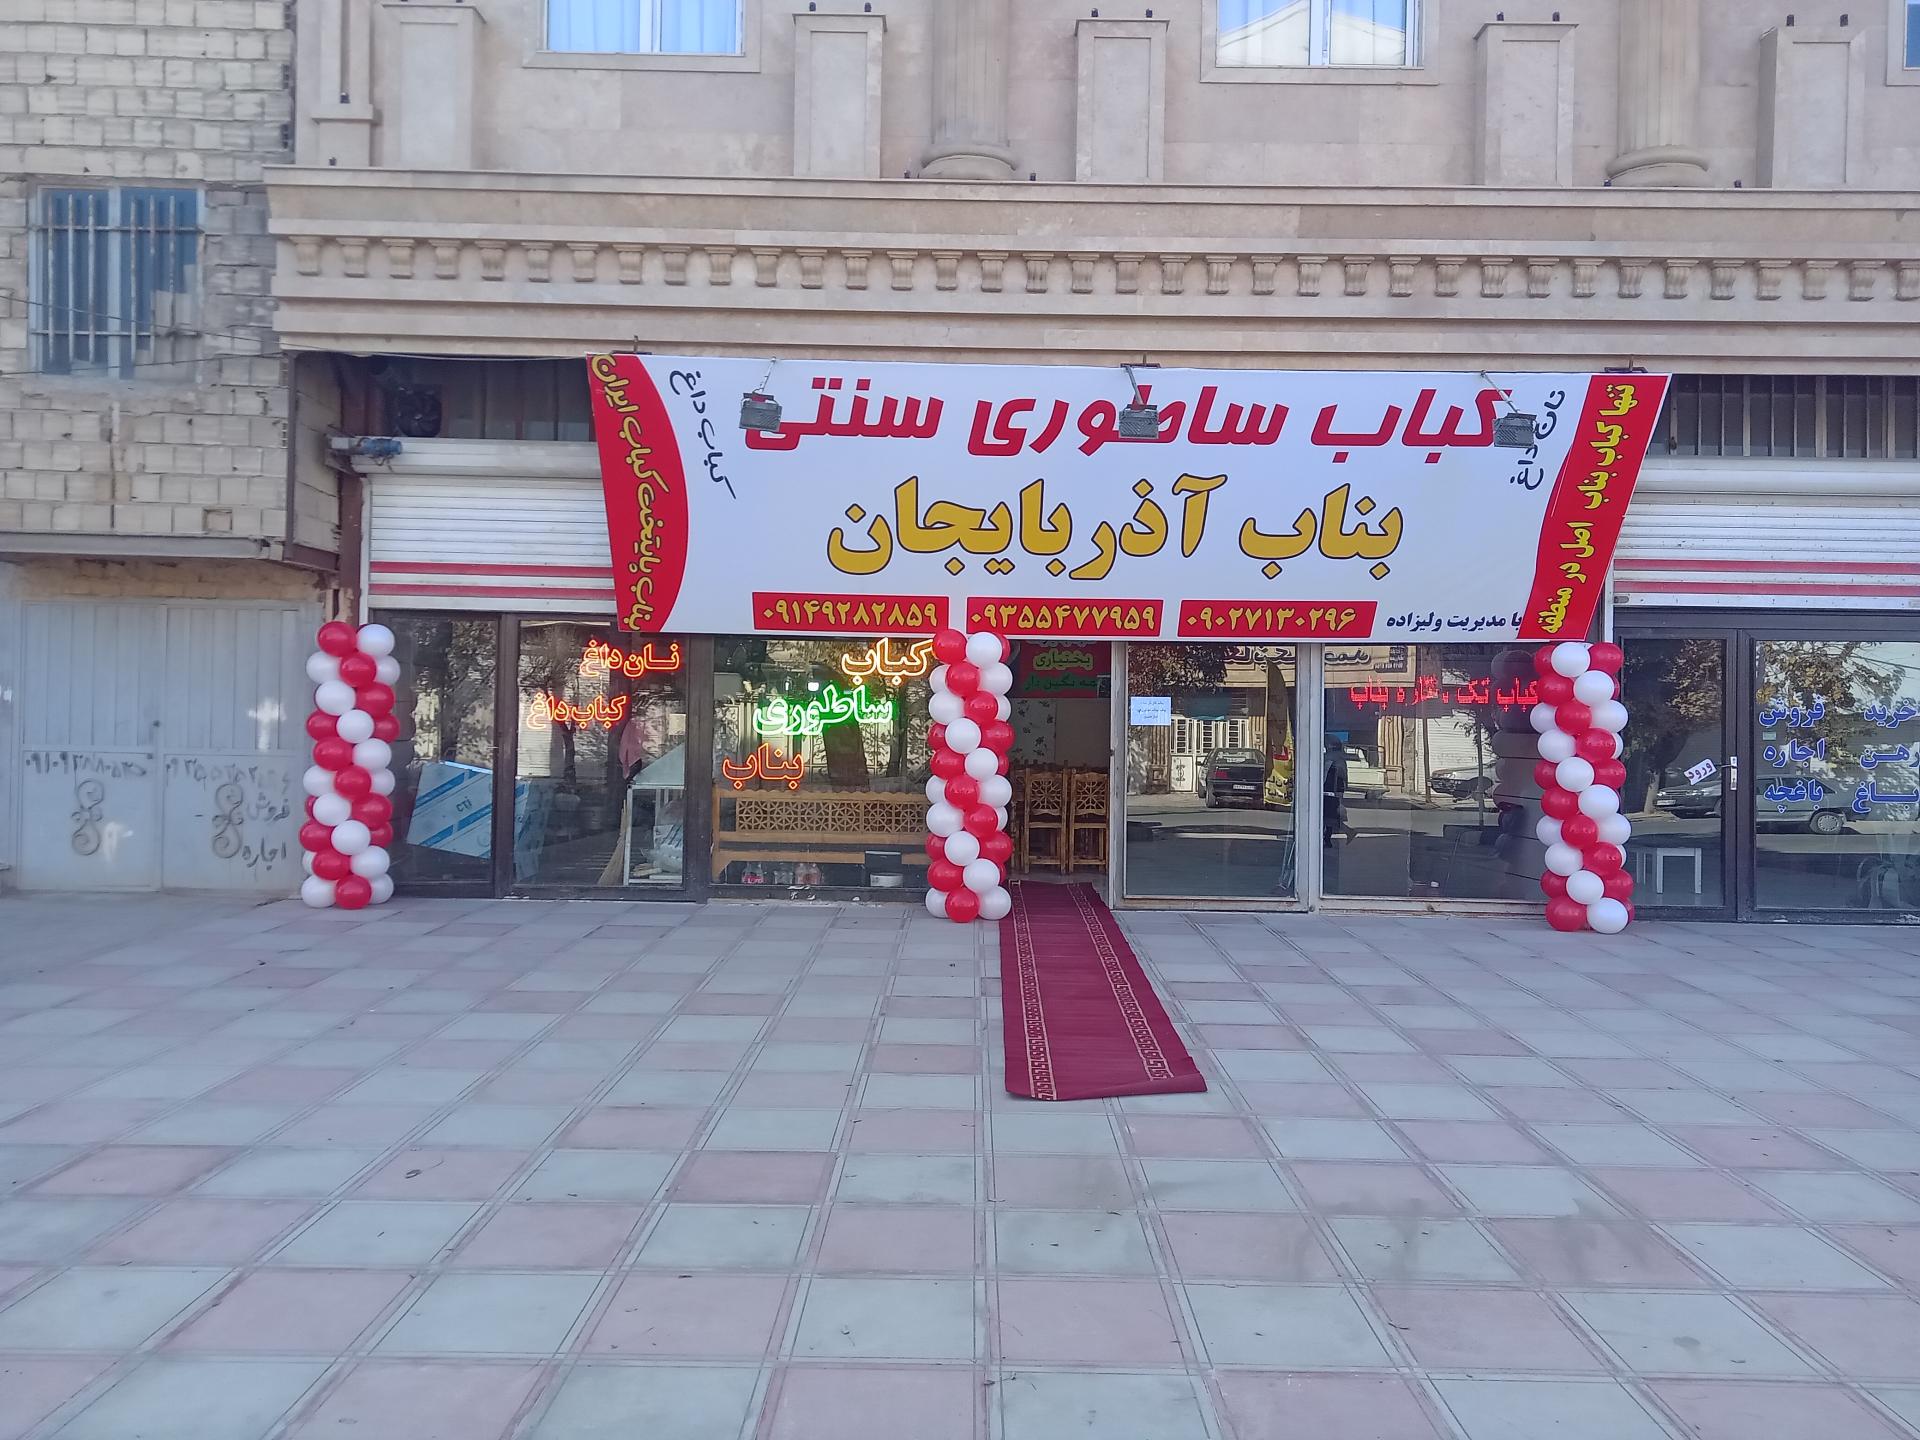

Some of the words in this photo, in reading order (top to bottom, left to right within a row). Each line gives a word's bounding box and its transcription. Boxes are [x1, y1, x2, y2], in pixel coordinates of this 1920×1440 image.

[591, 354, 640, 413] ایران
[669, 370, 706, 414] داغ
[1598, 383, 1639, 416] تنها
[745, 377, 943, 451] سنتی
[967, 385, 1289, 456] ساطوری
[1311, 389, 1513, 464] کباب
[1535, 390, 1566, 440] نان
[618, 416, 669, 492] کباب
[697, 418, 737, 499] کباب
[1589, 421, 1630, 467] کباب
[1510, 444, 1545, 490] داغ
[1576, 470, 1619, 510] بناب
[628, 482, 664, 574] پایتخت
[828, 472, 1228, 580] آذربایجان
[1239, 483, 1404, 580] بناب
[1559, 521, 1595, 558] اصل
[1558, 562, 1587, 584] در
[623, 576, 655, 631] بناب
[762, 599, 938, 626] ۰۹۱۴۹۲۸۲۸۵۹
[971, 603, 1155, 628] ۰۹۳۵۵۴۷۷۹۵۹
[1186, 606, 1358, 631] ۰۹۰۲۷۱۳۰۲۹۶
[1386, 611, 1443, 632] ولیزاده
[1511, 611, 1523, 632] با
[1537, 587, 1574, 634] منطقه
[1447, 614, 1507, 632] مدیریت
[580, 639, 622, 677] داغ
[623, 643, 680, 677] نان
[841, 637, 934, 686] کباب
[1033, 648, 1093, 670] بختیاری
[527, 692, 570, 729] داغ
[570, 695, 627, 729] کباب
[752, 683, 894, 736] ساطوری
[1759, 694, 1826, 728] فروش
[1864, 697, 1918, 728] خرید
[721, 742, 805, 790] بناب
[1763, 738, 1826, 767] اجاره
[1860, 743, 1920, 768] رهن
[1688, 763, 1713, 780] ورود
[1763, 780, 1824, 813] باغچه
[1852, 781, 1920, 813] باغ
[241, 837, 287, 871] اجاره
